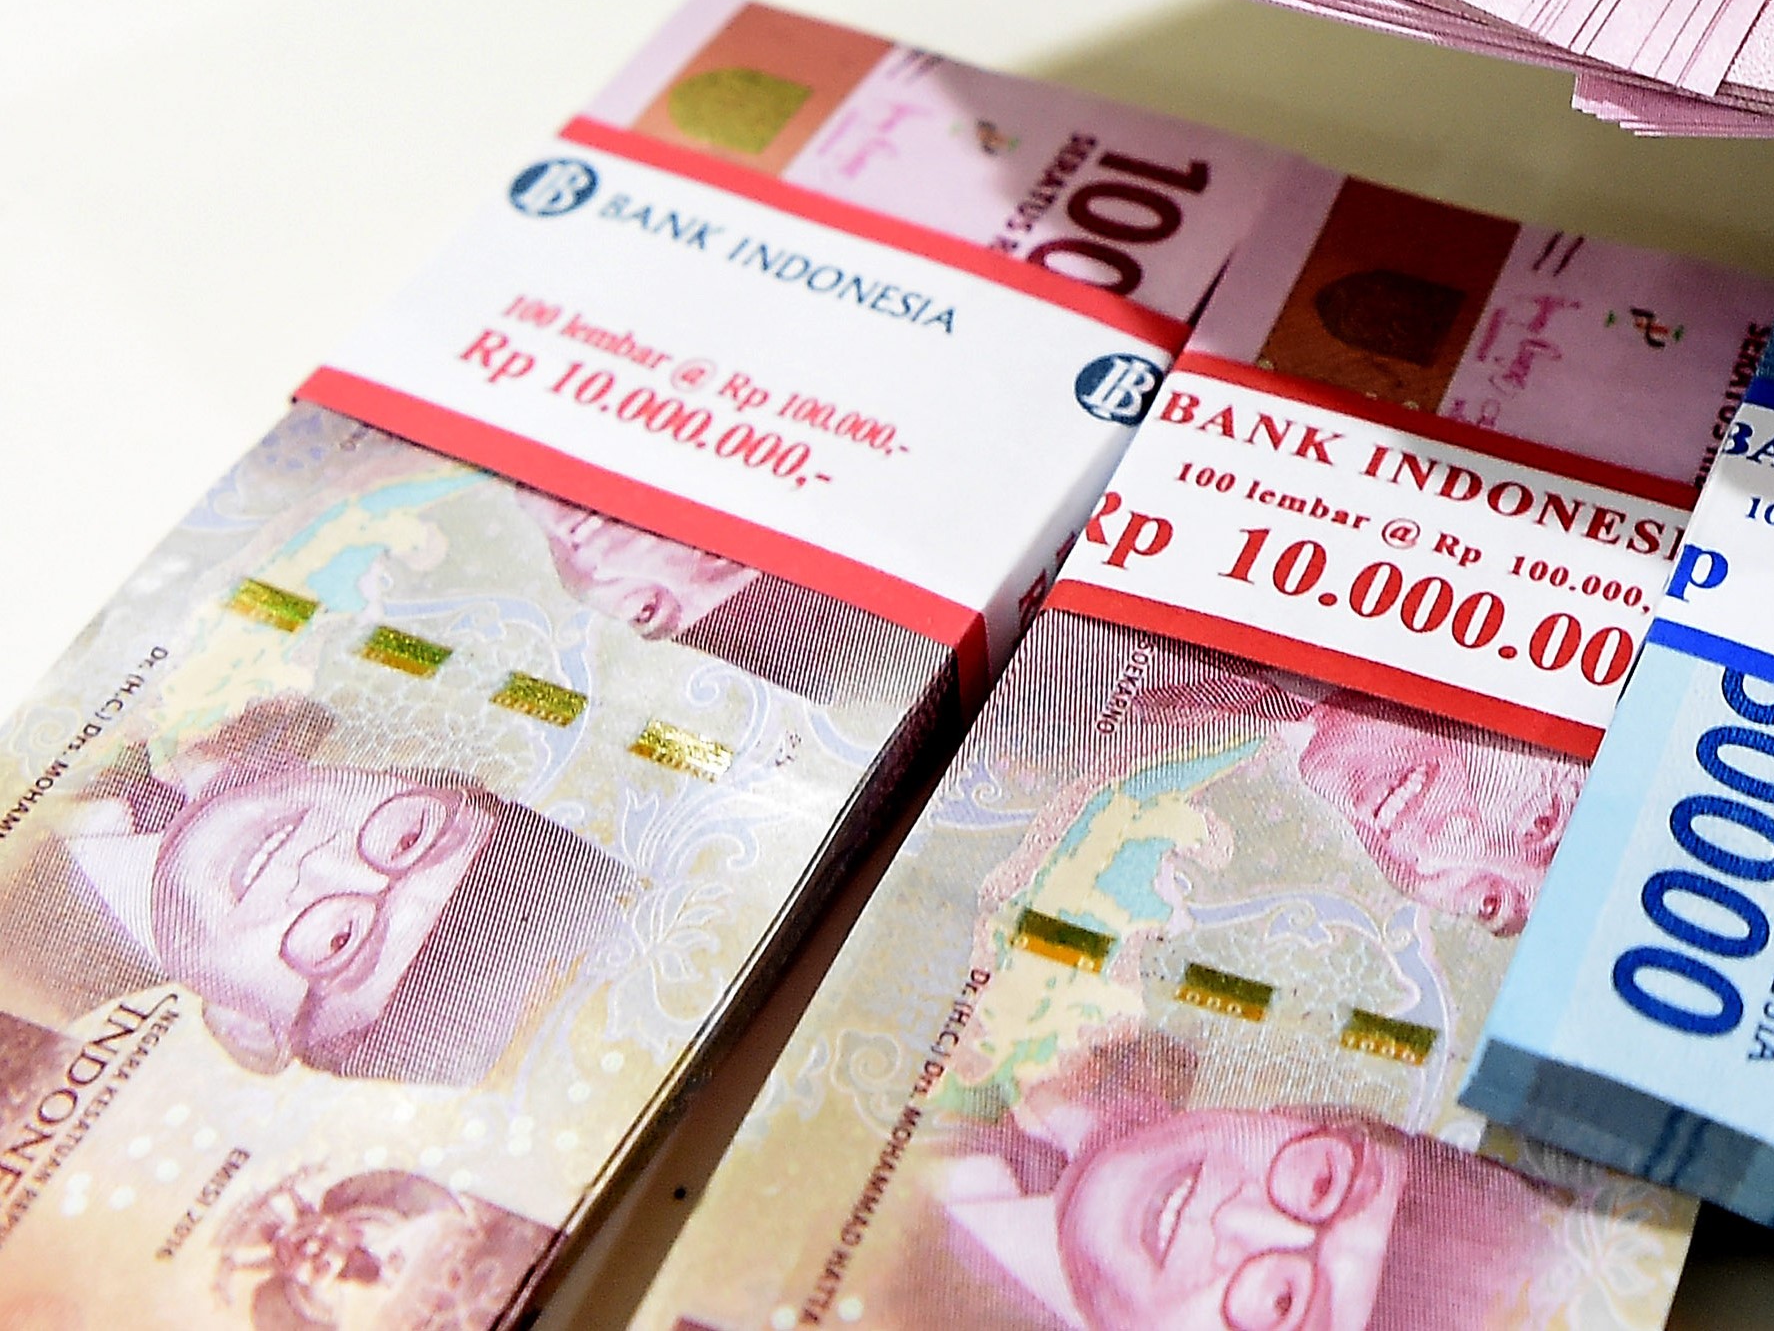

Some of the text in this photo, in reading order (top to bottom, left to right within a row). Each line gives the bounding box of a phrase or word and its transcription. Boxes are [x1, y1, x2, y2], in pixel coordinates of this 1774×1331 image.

[600, 195, 956, 335] BANK INDONESIA
[459, 328, 832, 488] Rp 10.000.000,-
[503, 295, 909, 457] 100 lembar @ Rp 100.000,-
[1159, 390, 1343, 466] BANK
[1177, 462, 1651, 615] 100 lembar @ Rp 100.000,
[1665, 543, 1729, 602] p
[93, 674, 145, 721] (H.C.)
[138, 645, 169, 669] Dr.
[1096, 634, 1161, 739] SOEKARNO
[62, 722, 103, 756] Drs.
[112, 1009, 180, 1081] NEGARA
[32, 1085, 118, 1185] KESATUAN
[800, 968, 992, 1326] Dr. (H.C.) Drs. MOHAMMAD HATTA
